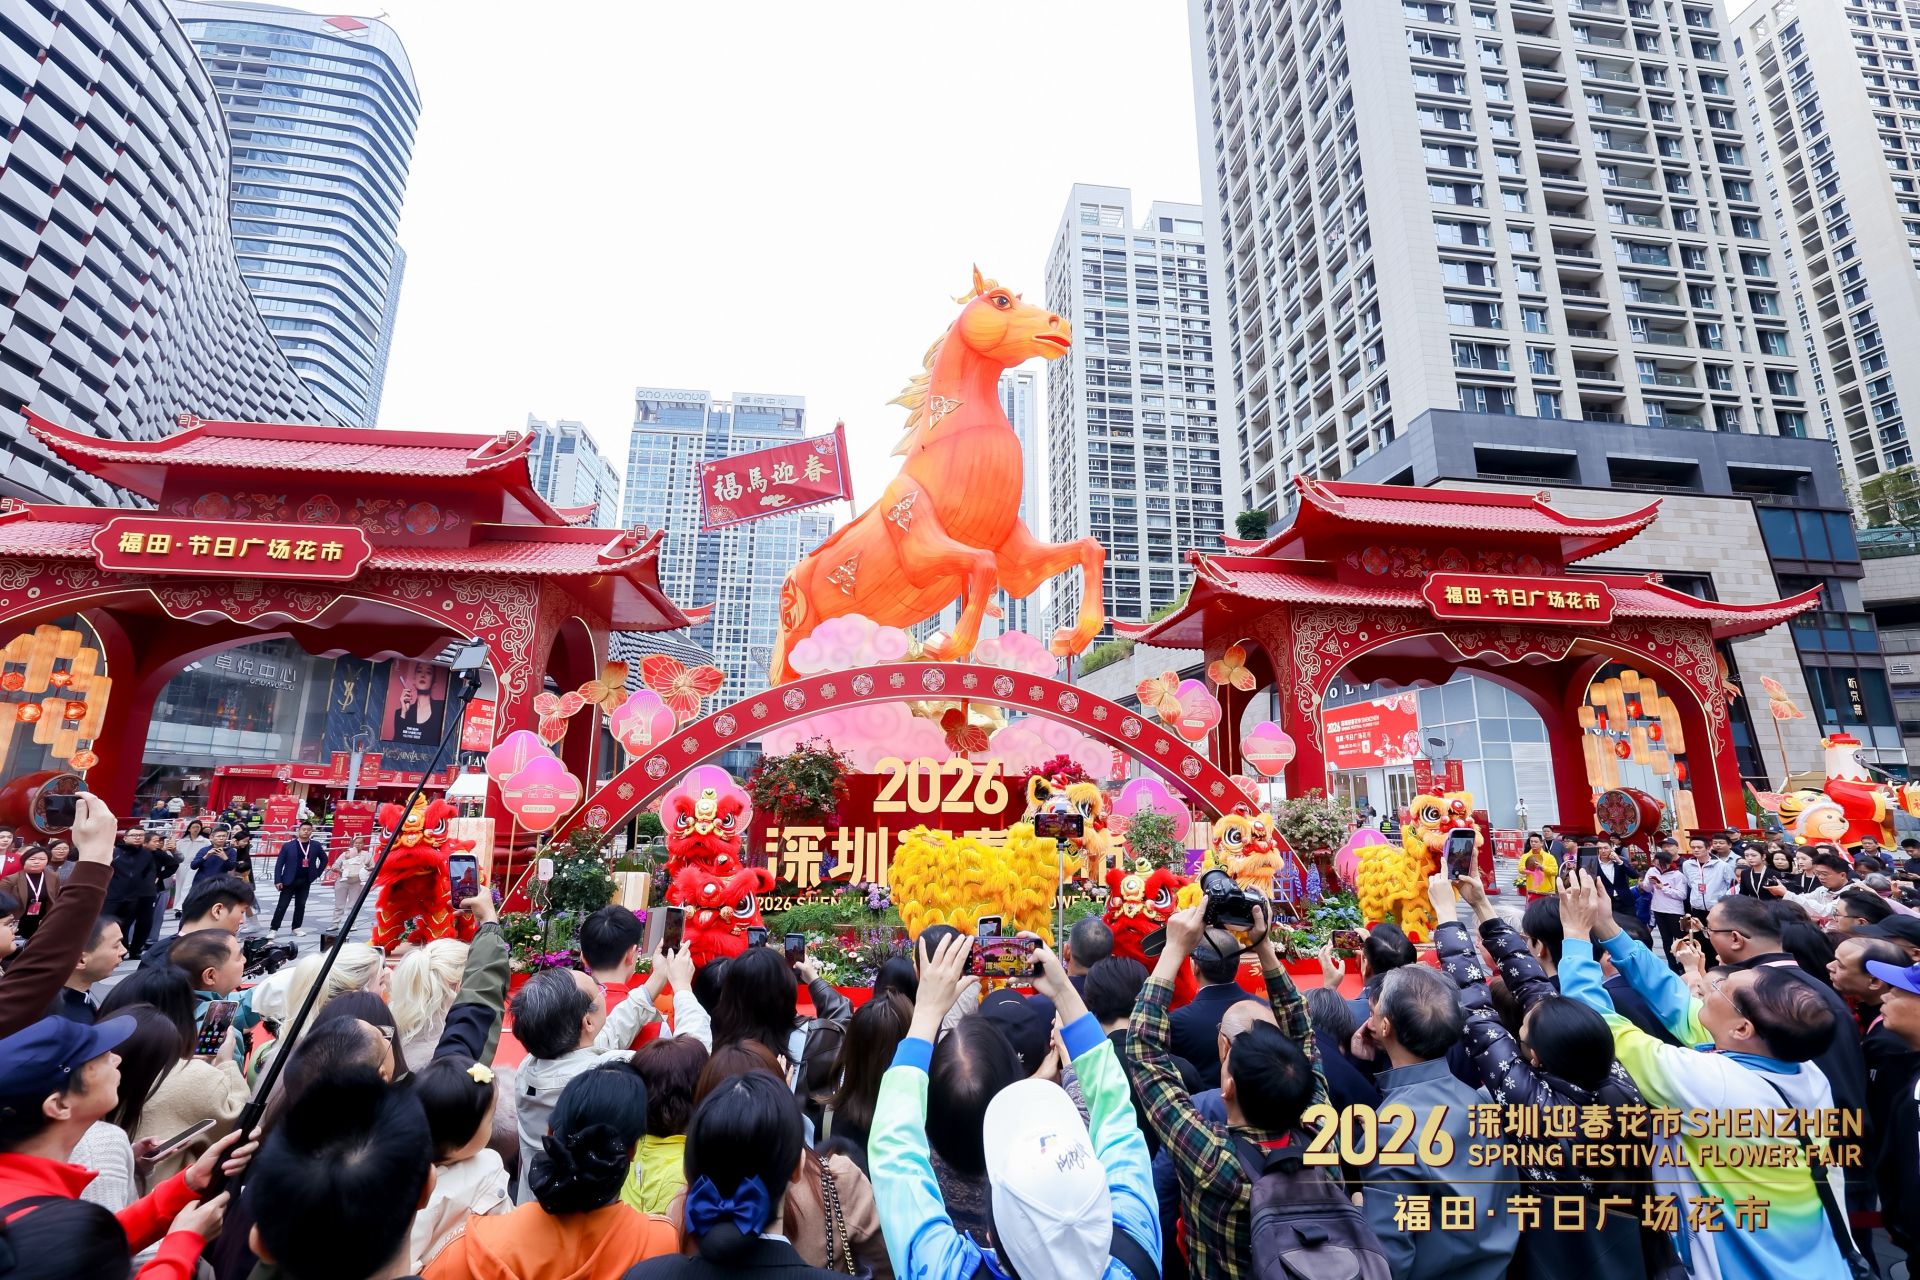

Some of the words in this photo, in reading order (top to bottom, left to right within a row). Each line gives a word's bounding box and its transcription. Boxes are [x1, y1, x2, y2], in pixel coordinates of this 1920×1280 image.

[712, 454, 833, 502] 福馬迎春
[118, 531, 344, 562] 福田·节日广场花市
[1444, 585, 1601, 610] 福田·节日广场花市
[214, 655, 296, 683] 卓悦中心
[873, 756, 1008, 814] 2026
[757, 896, 792, 911] 2026
